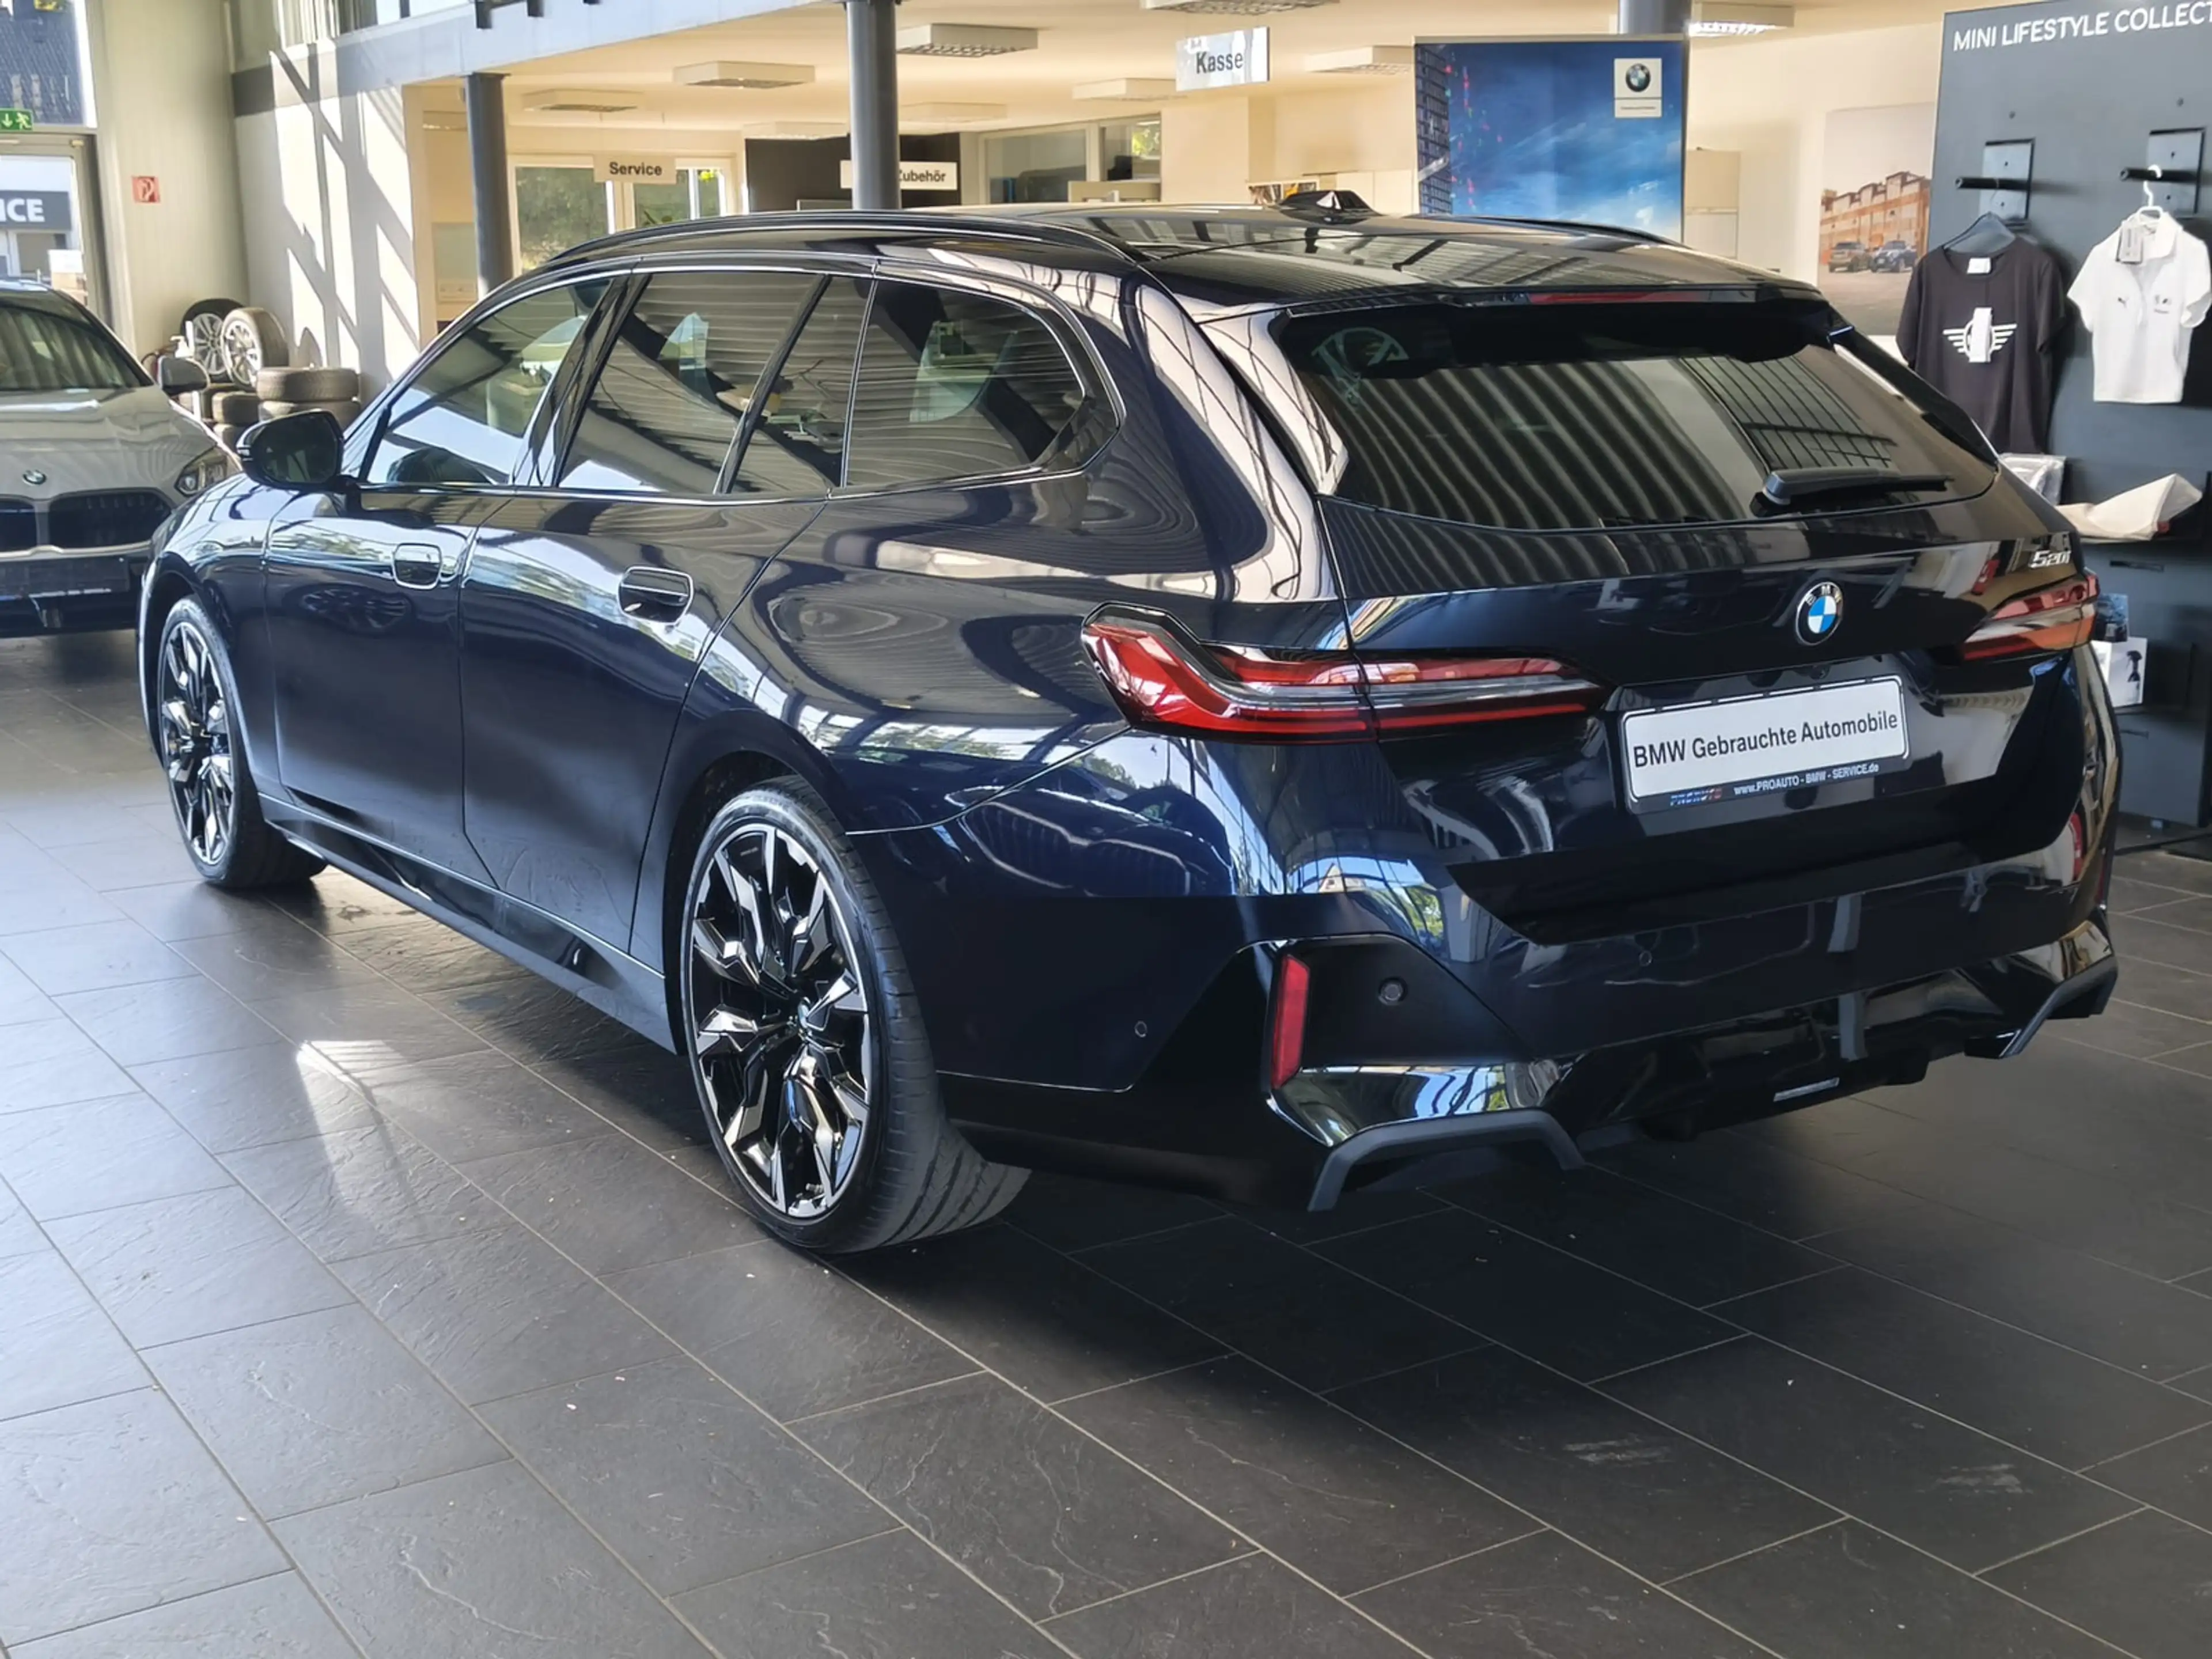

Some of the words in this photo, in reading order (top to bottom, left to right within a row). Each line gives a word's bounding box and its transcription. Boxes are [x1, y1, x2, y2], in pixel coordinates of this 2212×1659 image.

[1953, 26, 1997, 52] MINI
[2002, 12, 2110, 46] LIFESTYLE
[1196, 51, 1244, 74] Kasse
[609, 161, 662, 176] Service
[1634, 738, 1685, 768] BMW
[1692, 727, 1797, 759] Gebrauchte
[1801, 710, 1898, 743] Automobile
